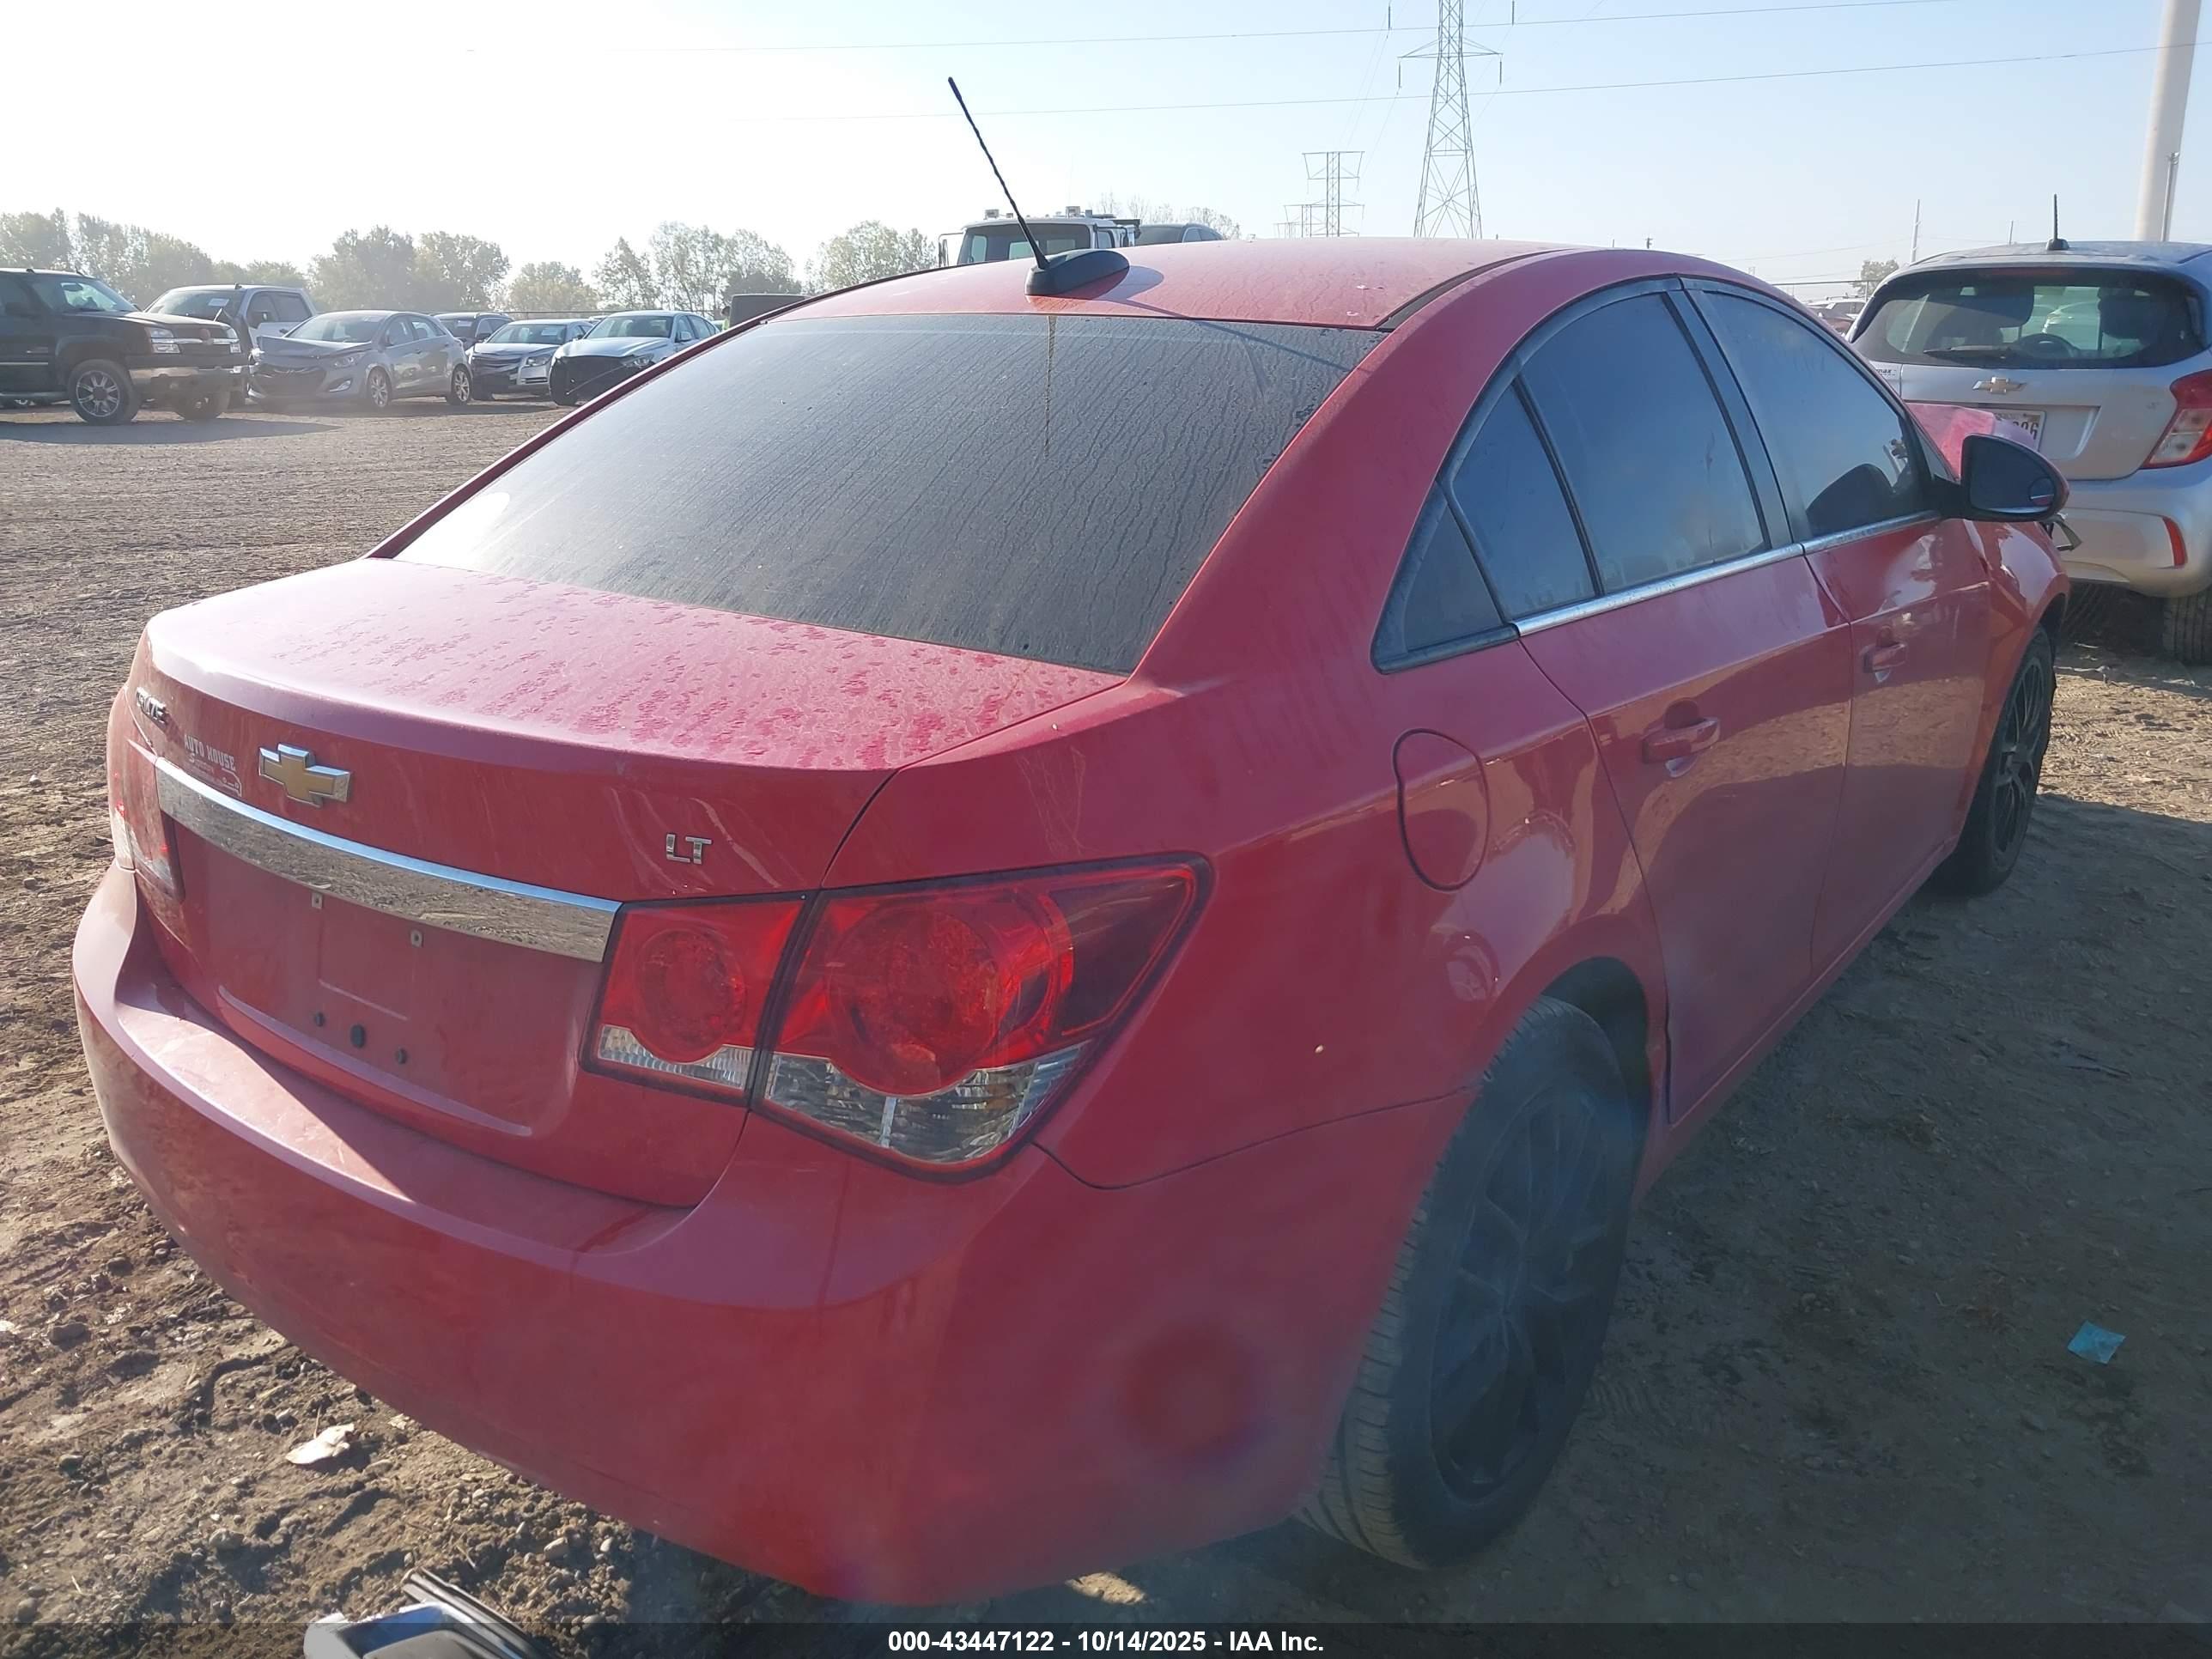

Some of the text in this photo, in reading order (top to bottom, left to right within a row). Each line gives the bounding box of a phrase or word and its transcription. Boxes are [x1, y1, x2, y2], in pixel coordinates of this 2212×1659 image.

[184, 733, 205, 757] AUTO
[206, 744, 236, 771] HOUSE
[665, 833, 713, 865] LT
